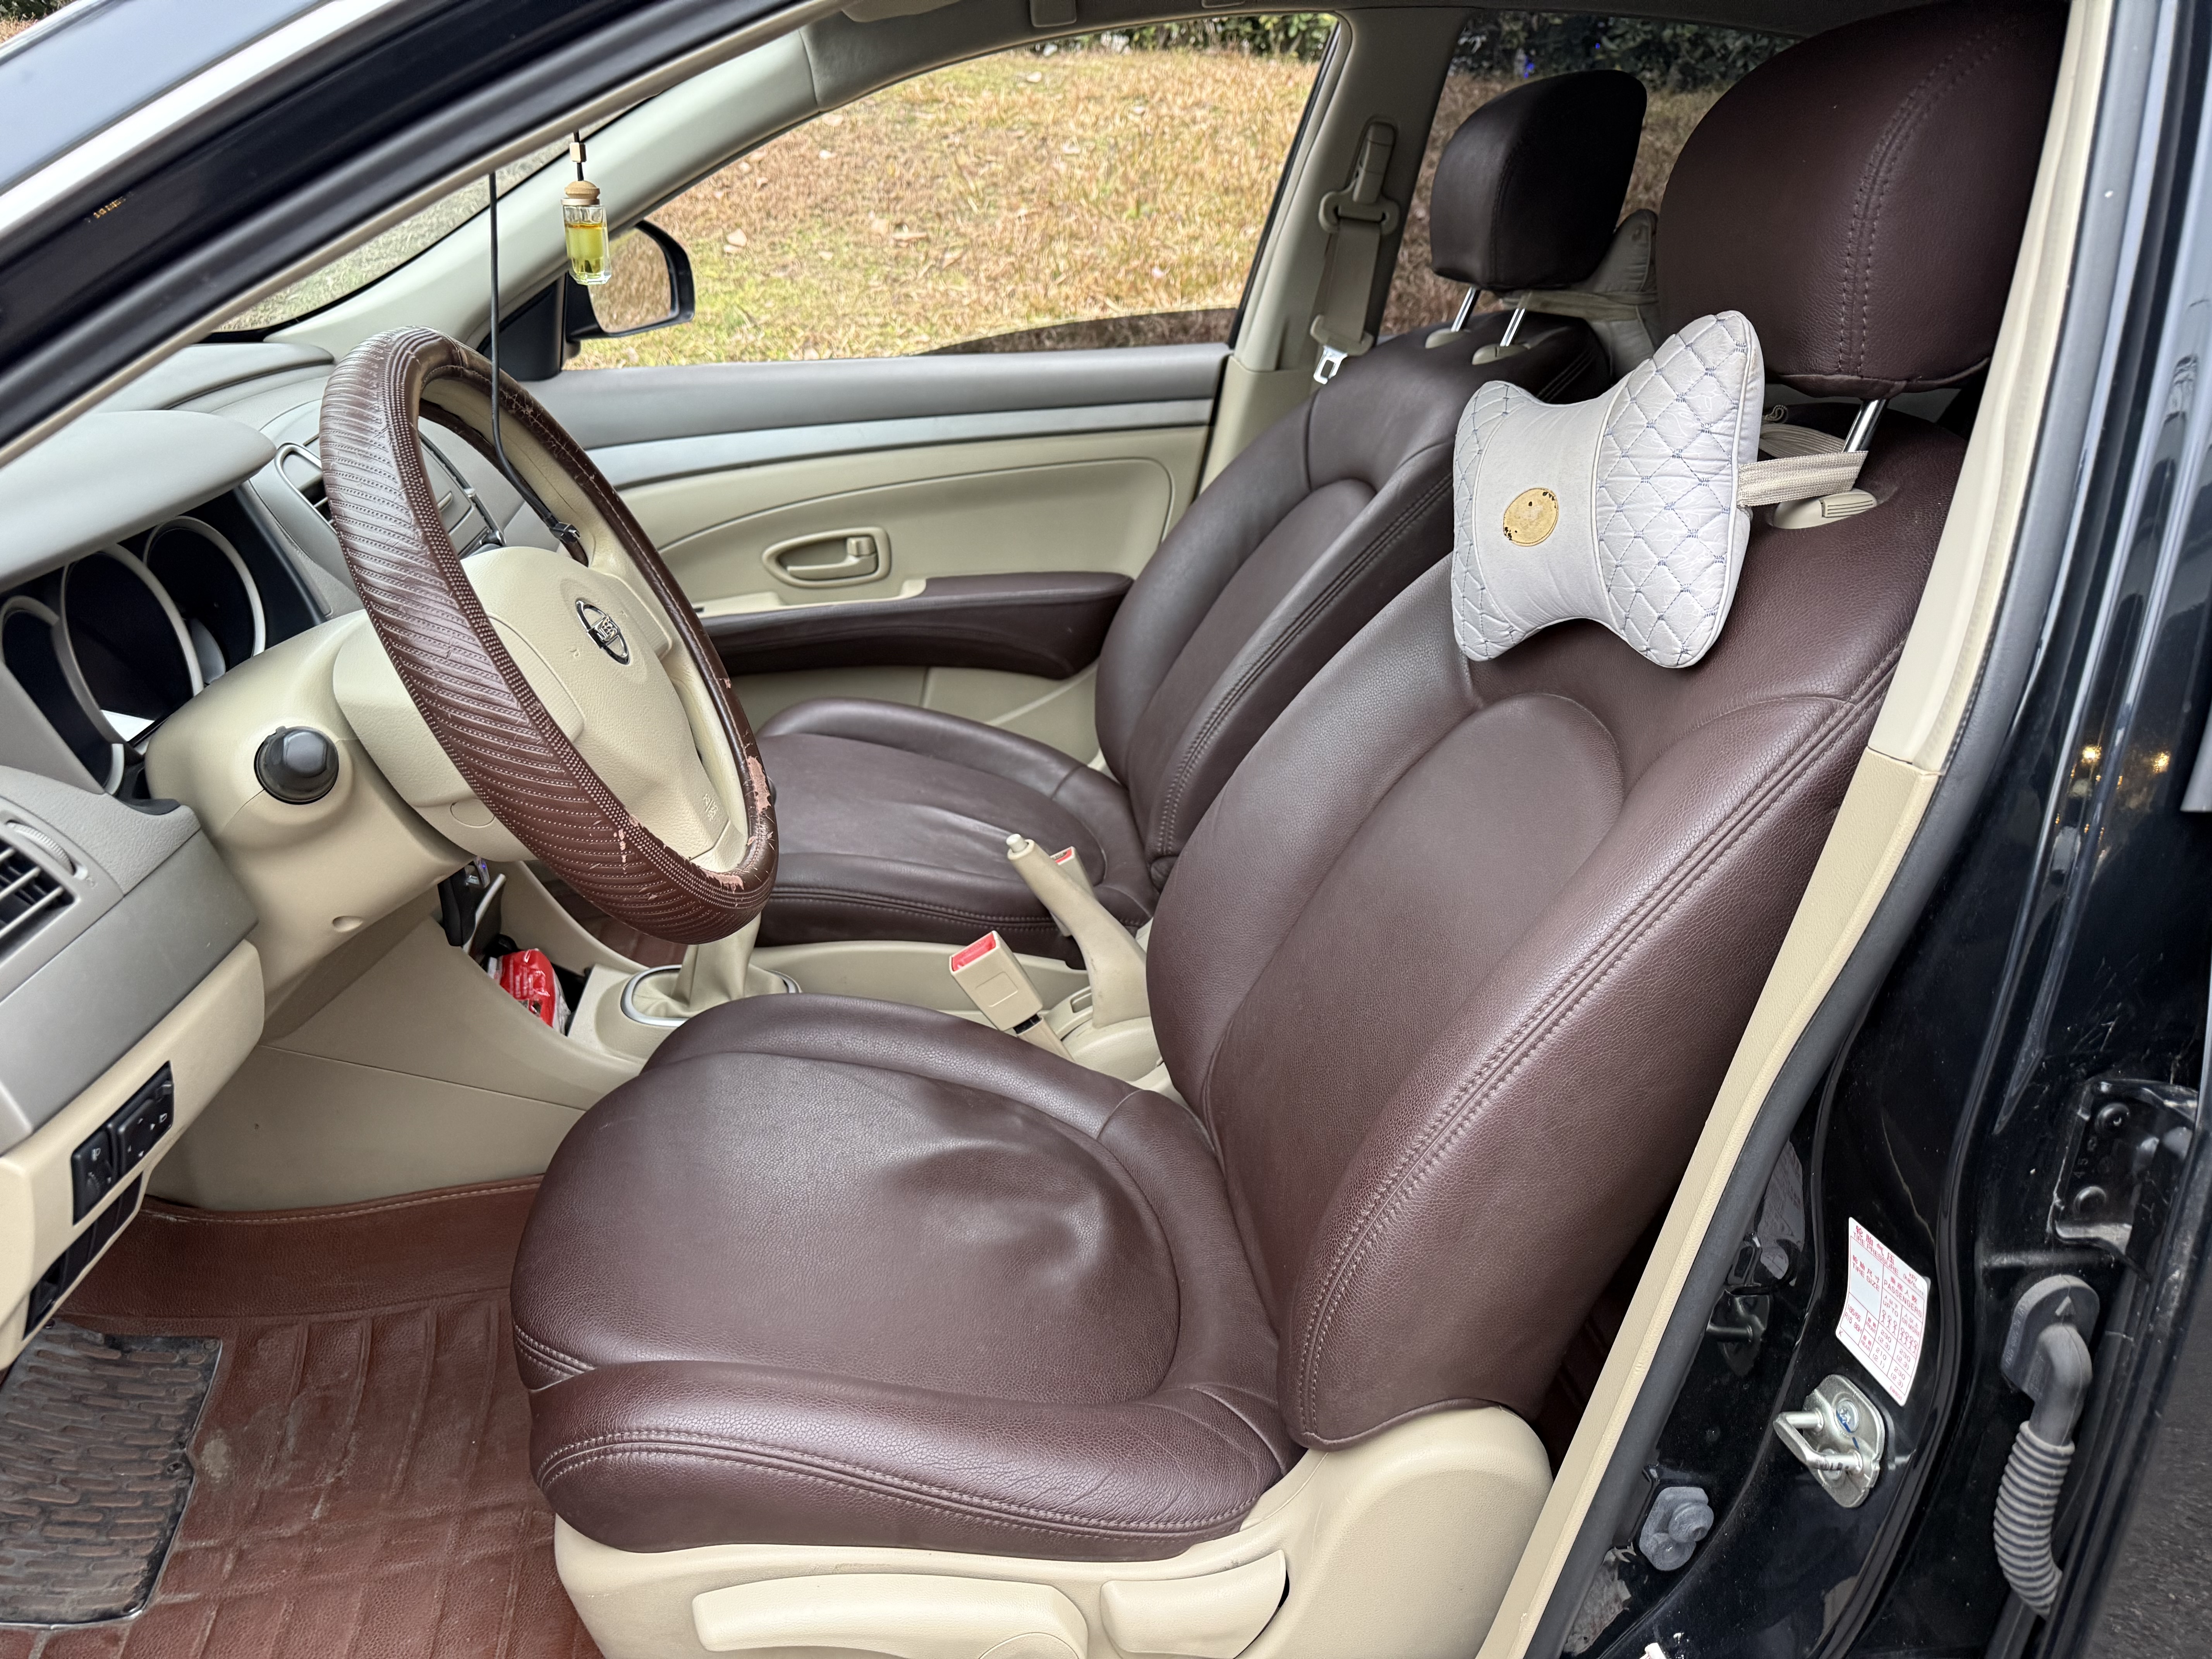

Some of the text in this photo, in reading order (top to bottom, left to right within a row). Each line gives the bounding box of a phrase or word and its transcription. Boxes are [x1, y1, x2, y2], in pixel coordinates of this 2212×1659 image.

[1853, 1231, 1899, 1274] TIRE PRESSURE
[1856, 1226, 1894, 1265] 轮胎气压
[1852, 1262, 1880, 1292] TIRE SIZE
[1853, 1255, 1880, 1283] 轮胎尺寸
[1884, 1279, 1922, 1318] PASSENGERS
[1883, 1300, 1898, 1317] UP TO
[1881, 1329, 1891, 1343] 230
[1908, 1323, 1920, 1337] MORE
[1878, 1336, 1890, 1351] (23)
[1872, 1353, 1884, 1369] (21)
[1876, 1347, 1887, 1360] 210
[1899, 1349, 1911, 1362] 230
[1896, 1355, 1909, 1370] (23)
[1891, 1372, 1903, 1388] (23)
[1894, 1366, 1905, 1380] 230
